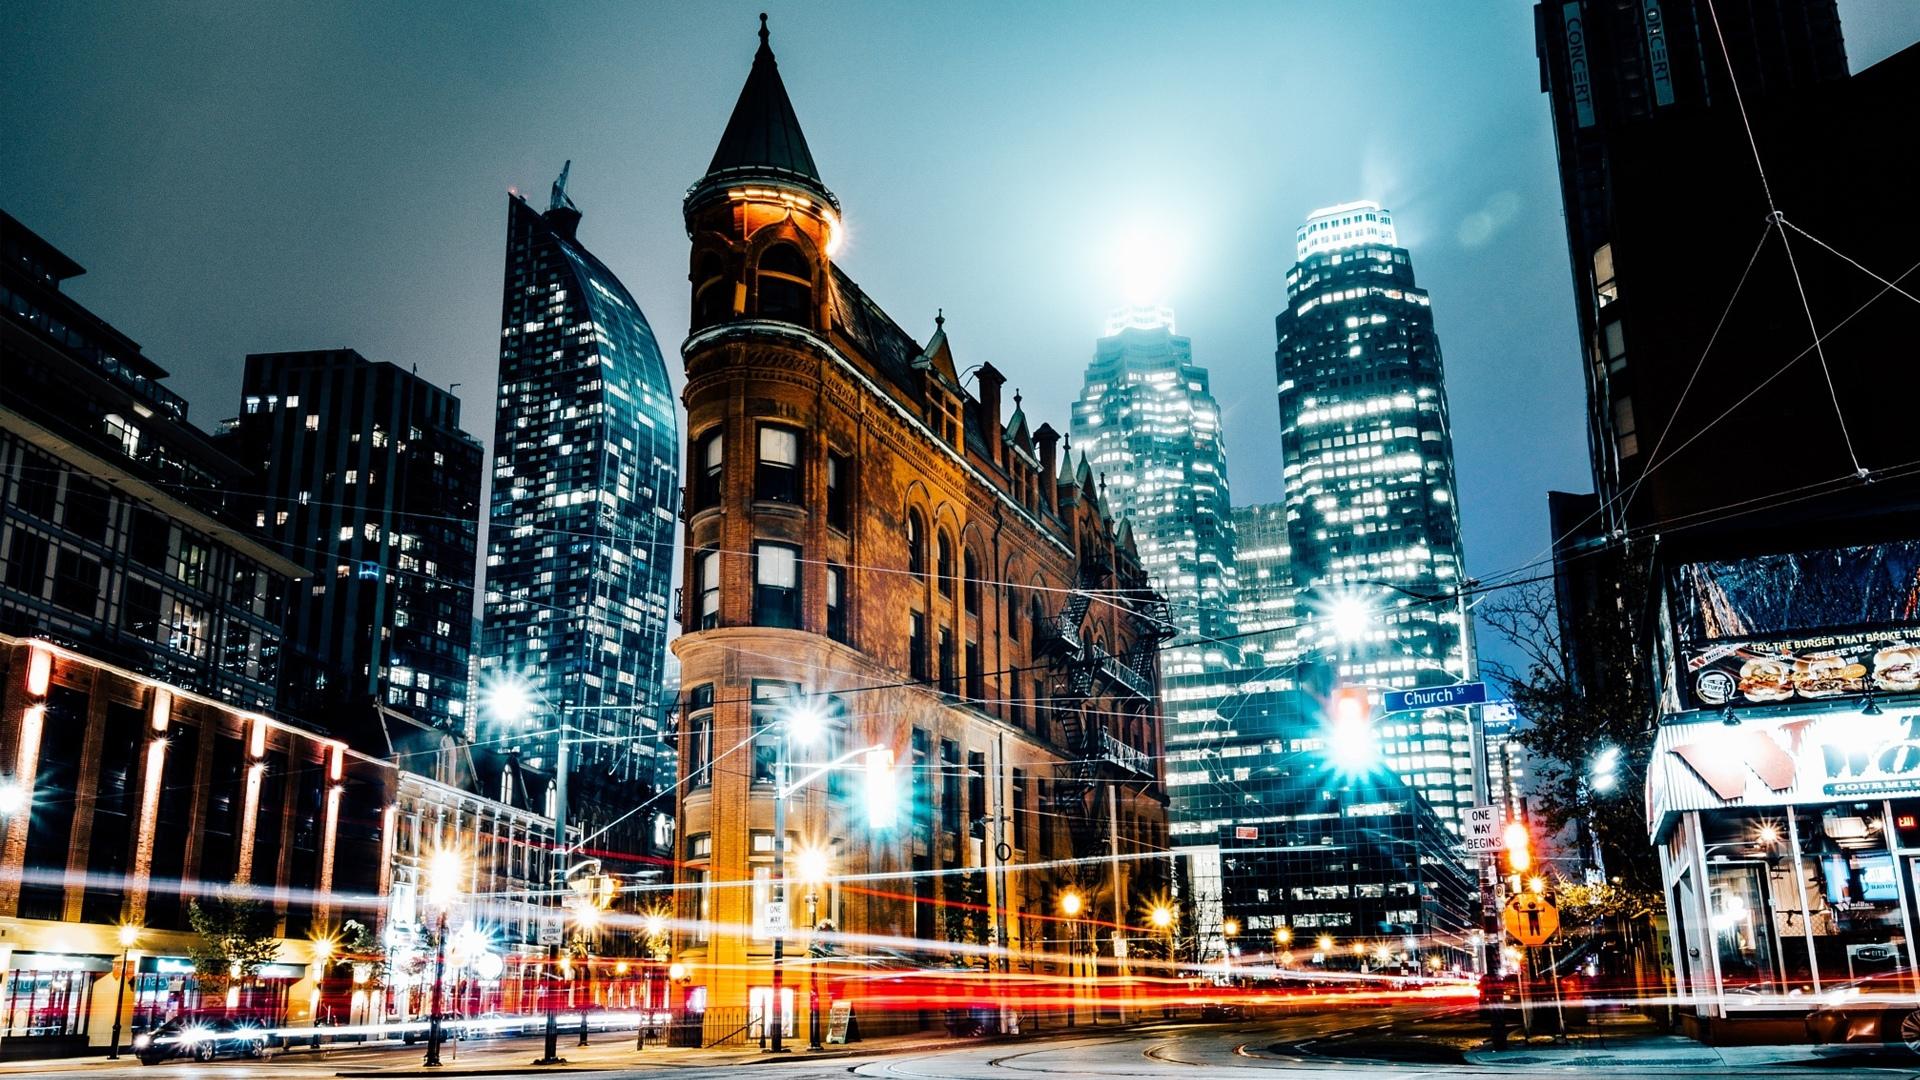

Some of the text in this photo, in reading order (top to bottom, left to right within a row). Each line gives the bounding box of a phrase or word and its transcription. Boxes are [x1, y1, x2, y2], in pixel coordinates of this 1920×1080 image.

[1567, 18, 1591, 107] CONCERT
[1752, 642, 1770, 652] TRY
[1772, 641, 1792, 651] THE
[1794, 636, 1835, 649] BURGER
[1836, 633, 1865, 645] THAT
[1866, 630, 1901, 642] BROKE
[1850, 643, 1872, 655] PBC
[1404, 687, 1464, 706] Church St
[1471, 810, 1490, 821] ONE
[1472, 823, 1491, 835] WAY
[1467, 837, 1502, 849] BEGINS
